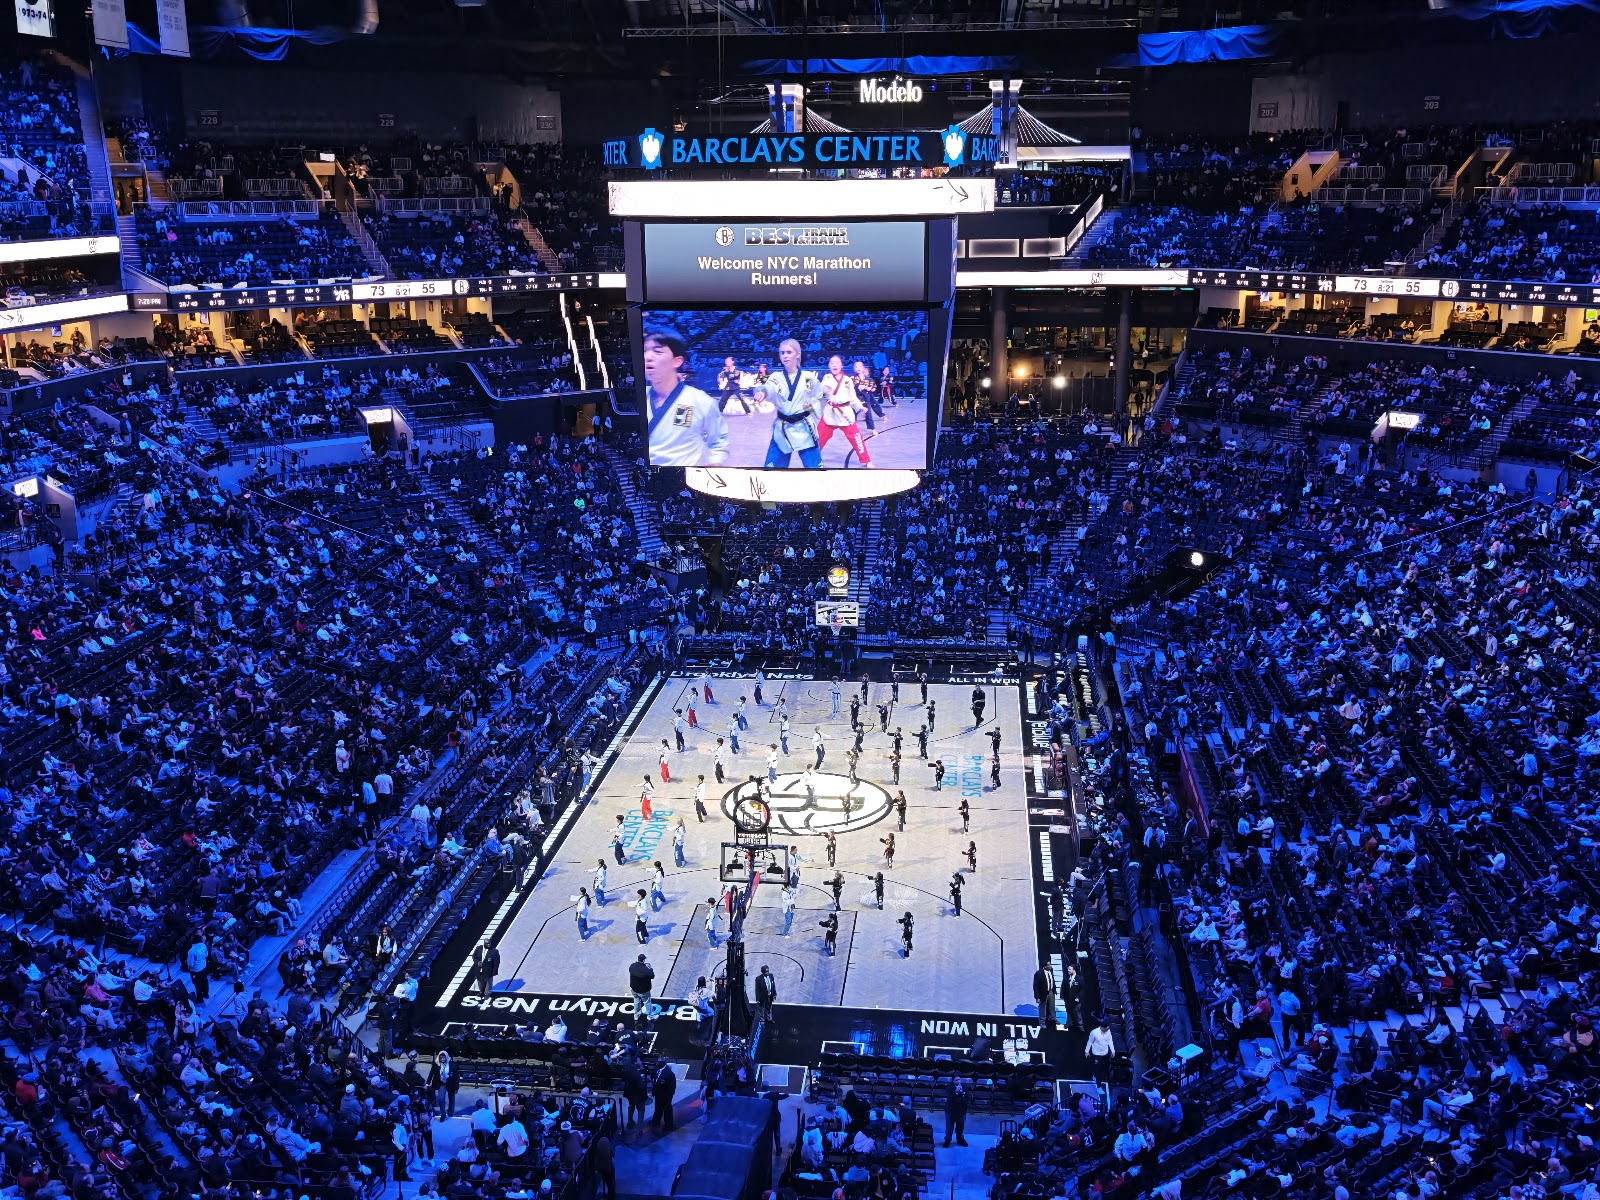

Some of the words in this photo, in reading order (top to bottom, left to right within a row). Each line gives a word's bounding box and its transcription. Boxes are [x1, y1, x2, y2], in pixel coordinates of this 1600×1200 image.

[859, 78, 923, 103] Modelo
[1261, 109, 1274, 117] 202
[1423, 101, 1439, 110] 203
[380, 119, 394, 127] 229
[671, 137, 805, 163] BARCLAYS
[815, 136, 922, 162] CENTER
[744, 228, 804, 246] BEST
[803, 227, 847, 237] TRAILS
[697, 256, 764, 270] Welcome
[767, 256, 799, 270] NYC
[803, 256, 871, 270] Marathon
[751, 272, 818, 285] Runners!
[1353, 279, 1367, 290] 73
[1377, 284, 1394, 292] 8:21
[1405, 281, 1420, 293] 55
[370, 285, 386, 296] 73
[422, 283, 435, 294] 55
[961, 755, 982, 797] BARCLAYS
[629, 809, 674, 861] BARCLAYS
[460, 995, 539, 1014] Nets
[548, 995, 698, 1021] Brooklyn
[920, 1019, 969, 1036] WON
[976, 1022, 997, 1037] IN
[1004, 1023, 1041, 1039] ALL
